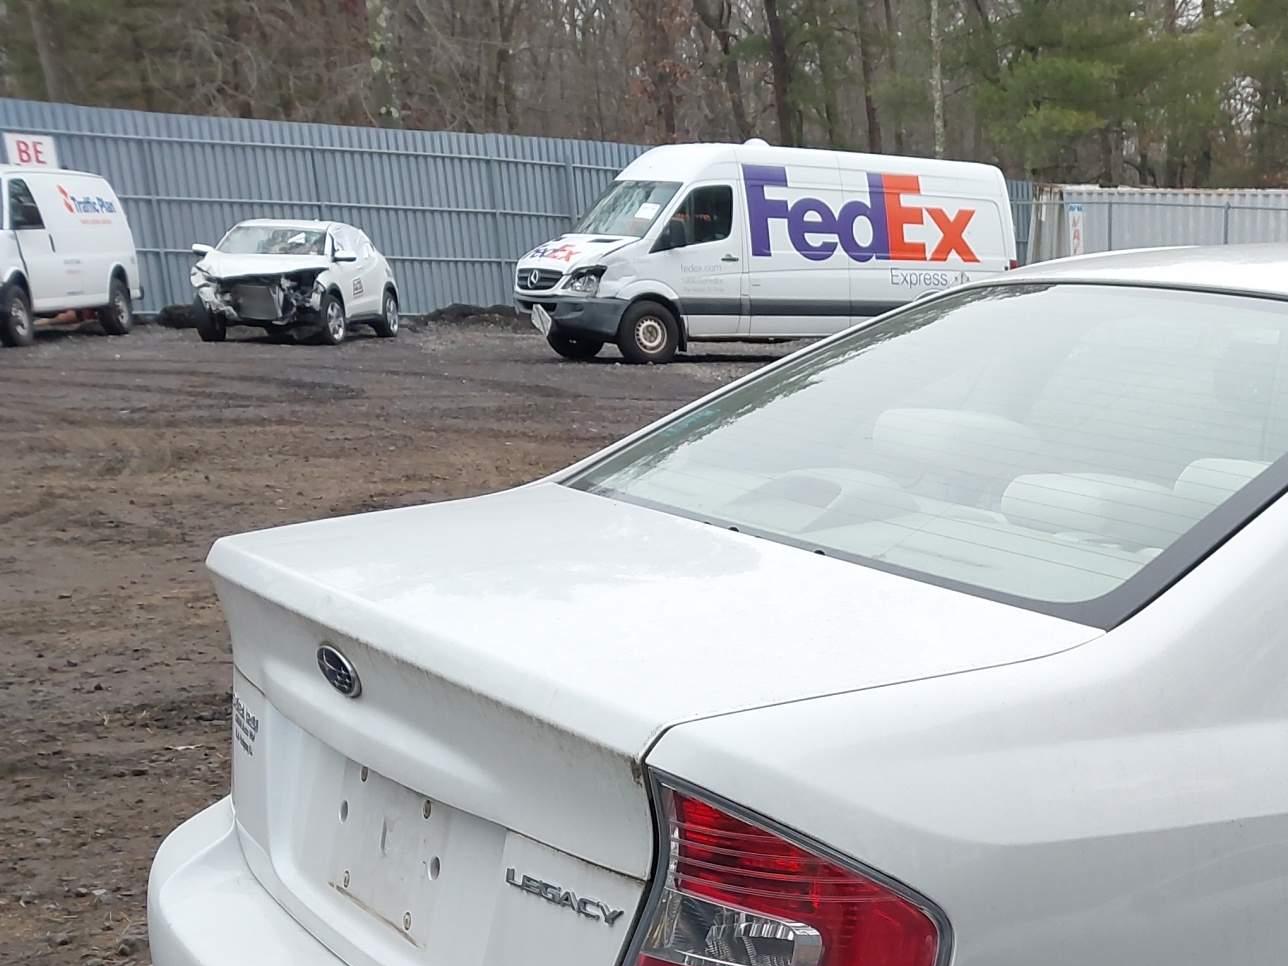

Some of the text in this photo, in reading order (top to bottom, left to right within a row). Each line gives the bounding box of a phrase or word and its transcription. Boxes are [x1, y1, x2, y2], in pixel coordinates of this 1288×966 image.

[16, 140, 48, 165] BE
[742, 163, 981, 263] FedEx
[890, 267, 949, 289] Express
[506, 867, 624, 926] LEGACY
